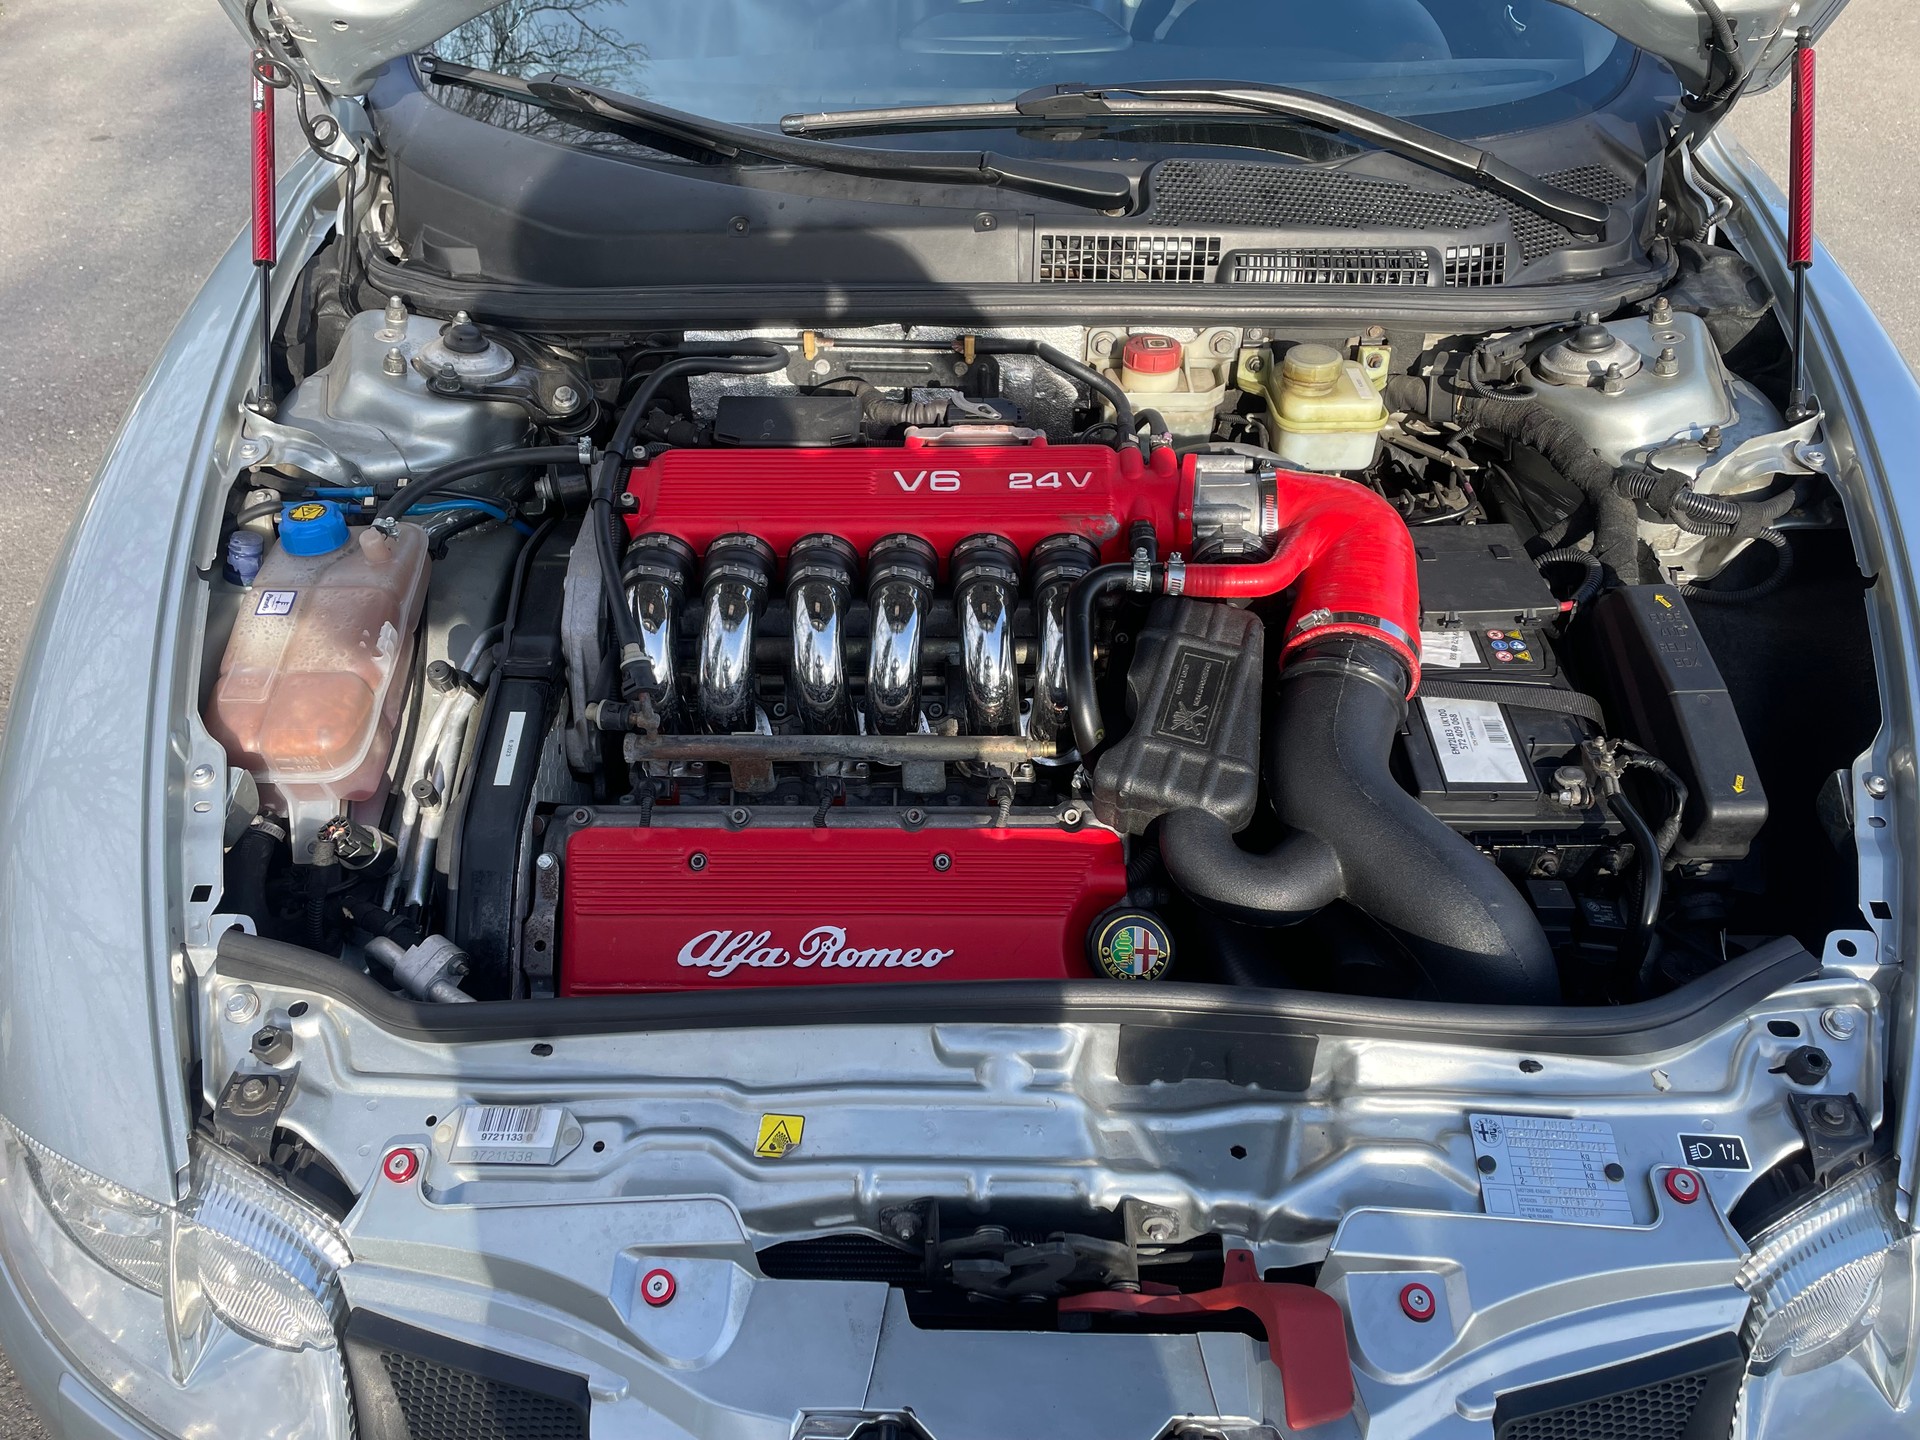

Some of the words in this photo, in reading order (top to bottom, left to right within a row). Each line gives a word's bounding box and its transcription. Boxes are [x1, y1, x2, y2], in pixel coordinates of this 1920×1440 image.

[893, 470, 961, 492] V6
[1449, 714, 1461, 727] 068
[1454, 726, 1464, 738] 409
[1458, 738, 1468, 750] 572
[677, 930, 791, 978] Alfa
[793, 925, 955, 968] Romeo
[1580, 1151, 1591, 1161] kg
[1719, 1143, 1740, 1160] 1%
[1582, 1161, 1593, 1171] kg
[1584, 1171, 1595, 1180] kg
[1586, 1180, 1597, 1190] kg
